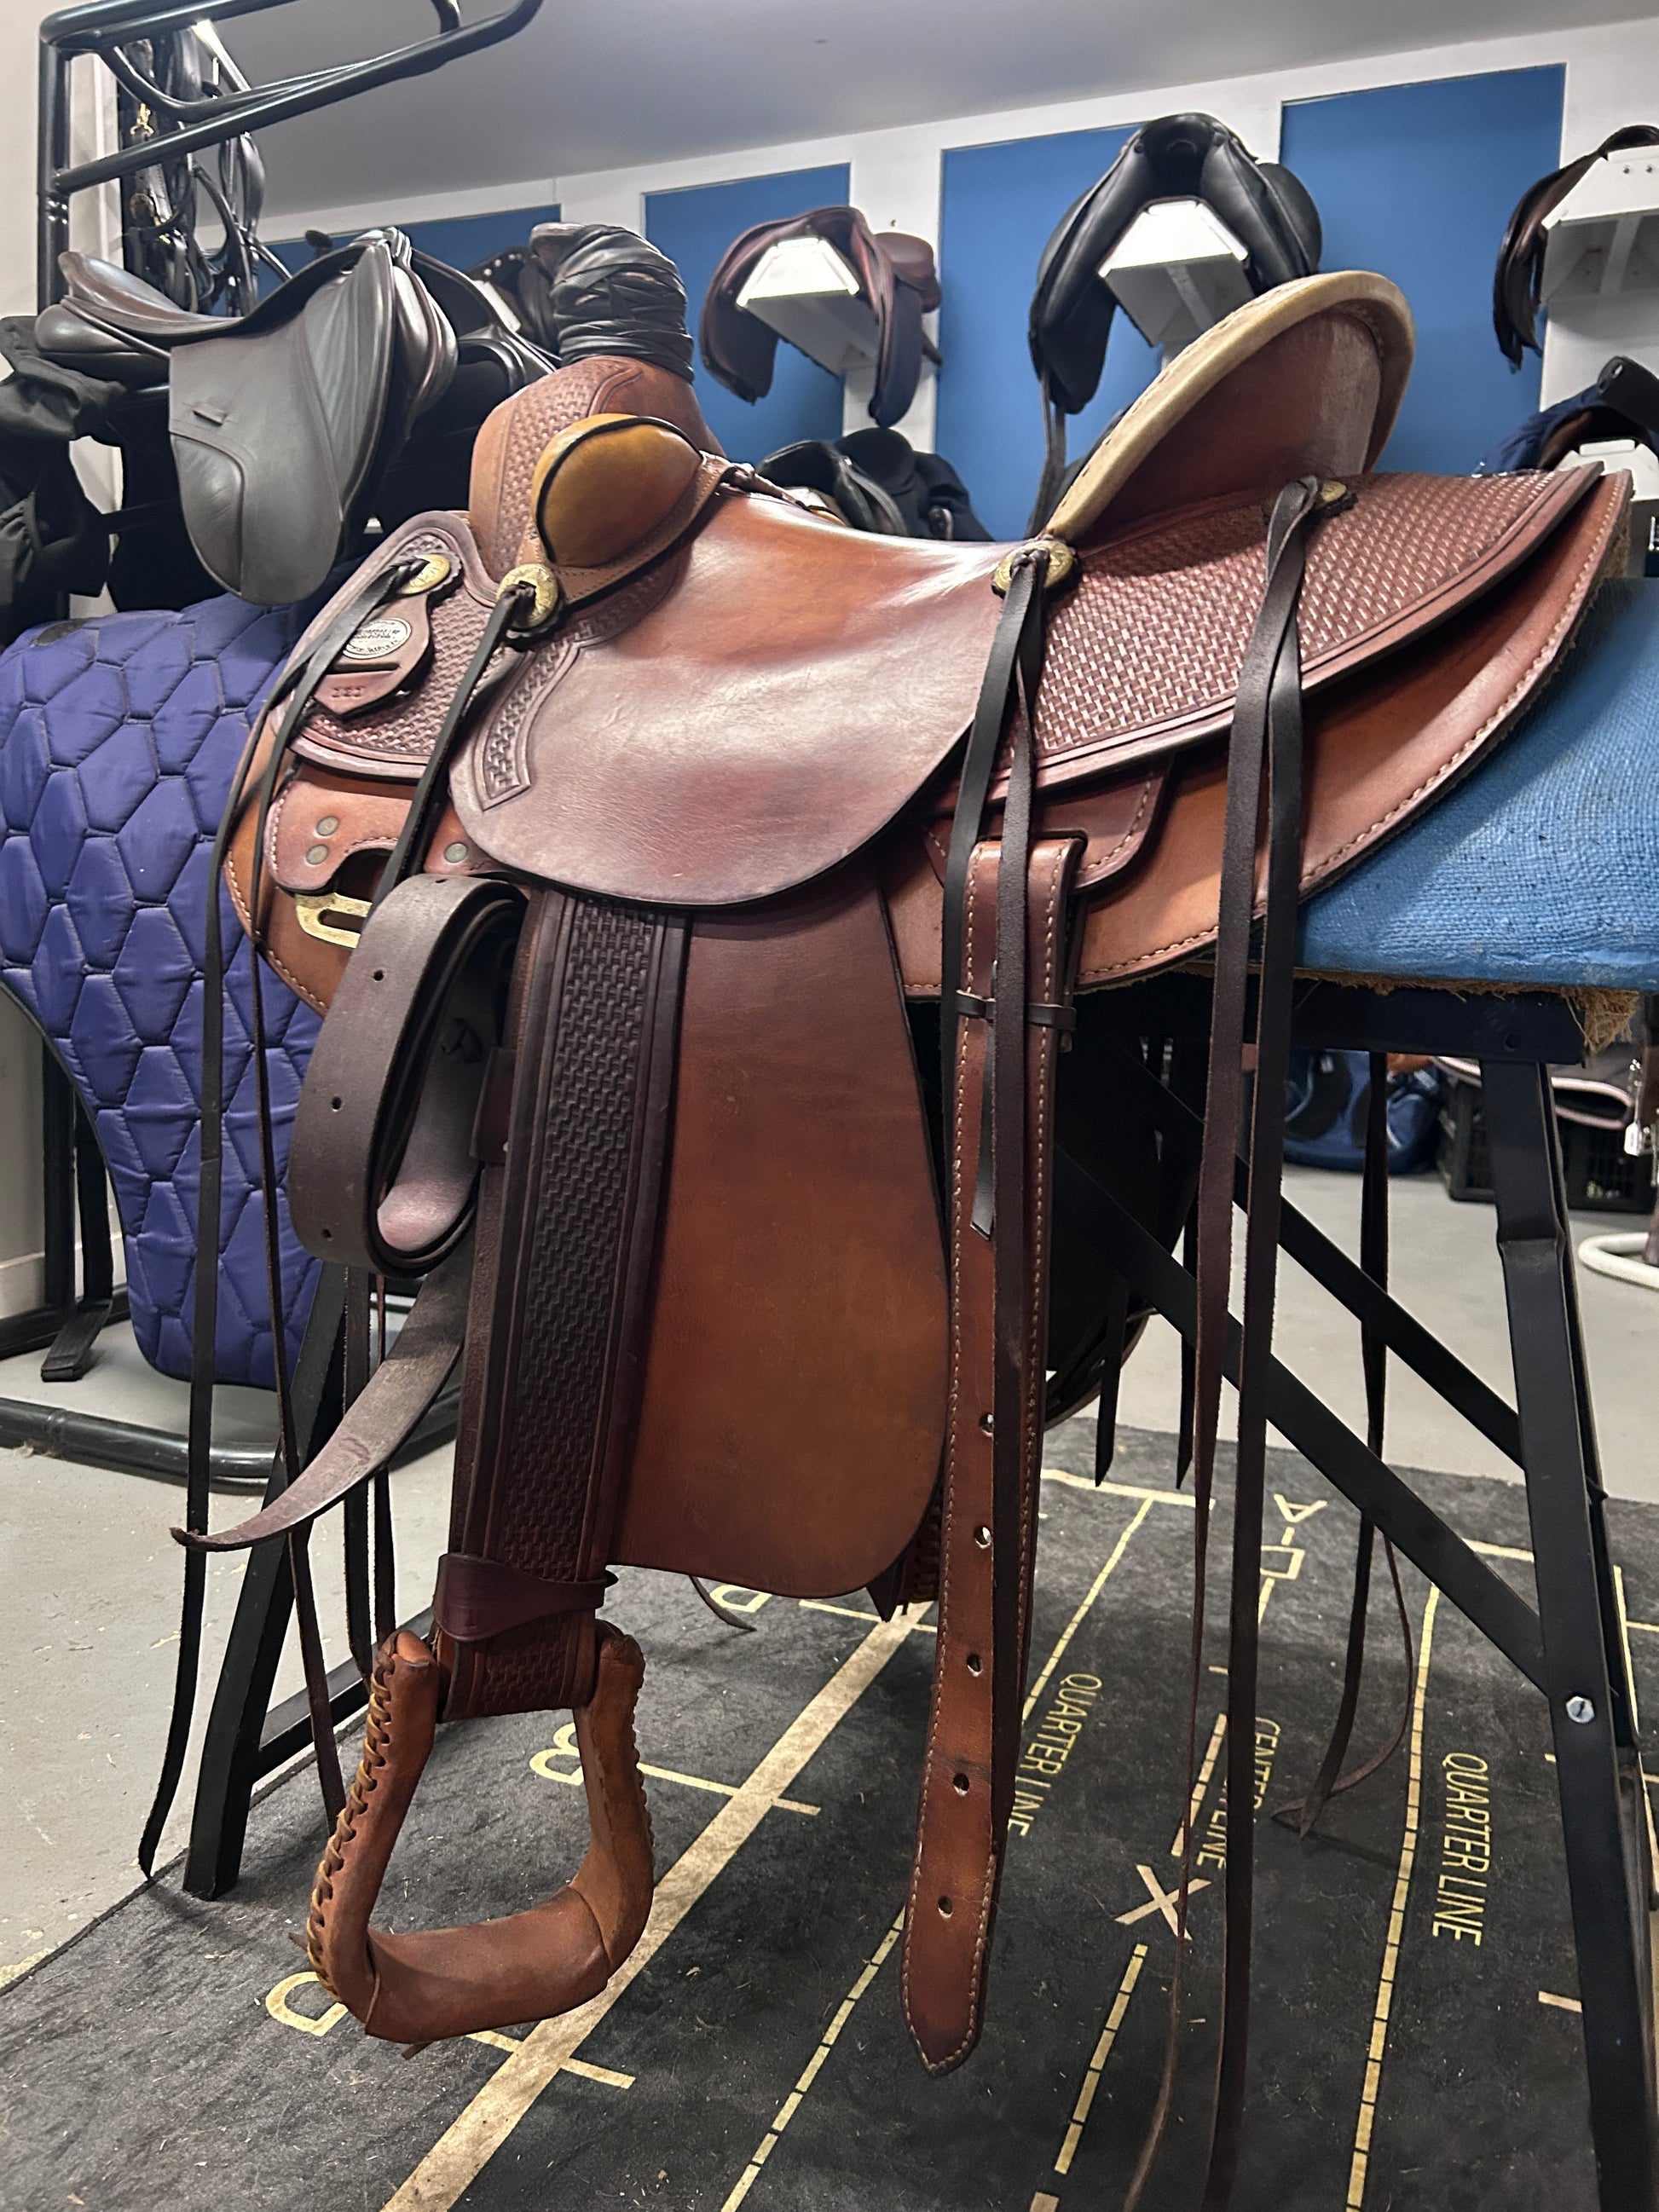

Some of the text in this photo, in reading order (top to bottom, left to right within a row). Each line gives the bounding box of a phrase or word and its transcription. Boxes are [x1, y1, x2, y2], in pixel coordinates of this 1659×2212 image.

[1273, 1493, 1328, 1523] A
[1020, 1673, 1102, 1775] QUARTER
[1432, 1753, 1491, 1947] QUARTER LINE
[1114, 1863, 1212, 1940] X
